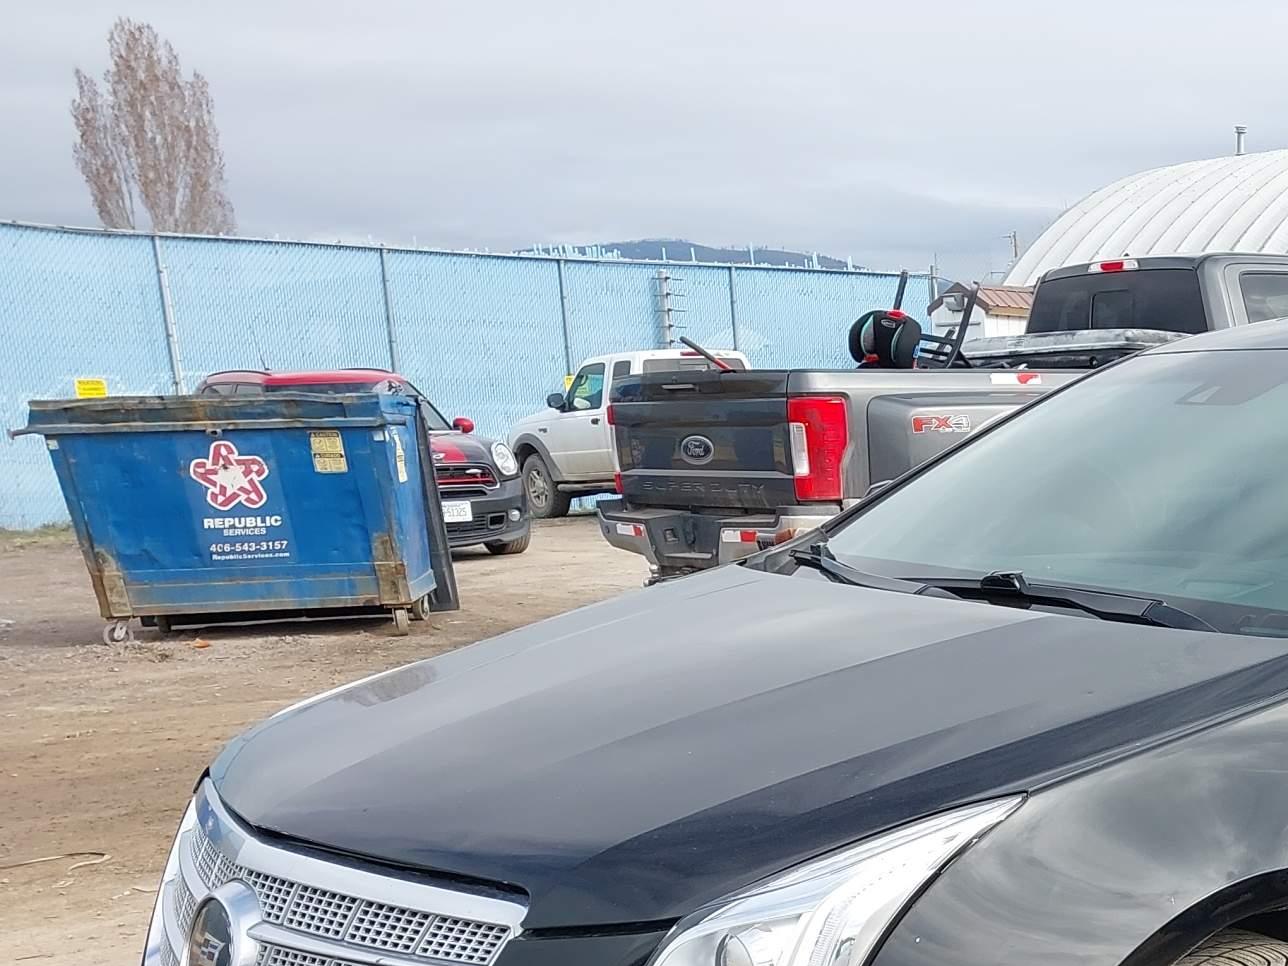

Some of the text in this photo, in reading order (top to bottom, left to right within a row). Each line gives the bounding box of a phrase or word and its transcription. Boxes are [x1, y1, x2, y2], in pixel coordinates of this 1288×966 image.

[911, 414, 971, 434] FX4
[203, 516, 282, 529] REPUBLIC
[223, 528, 267, 536] SERVICES
[209, 541, 288, 552] 406-543-3157
[212, 552, 290, 560] RepublicServices.com
